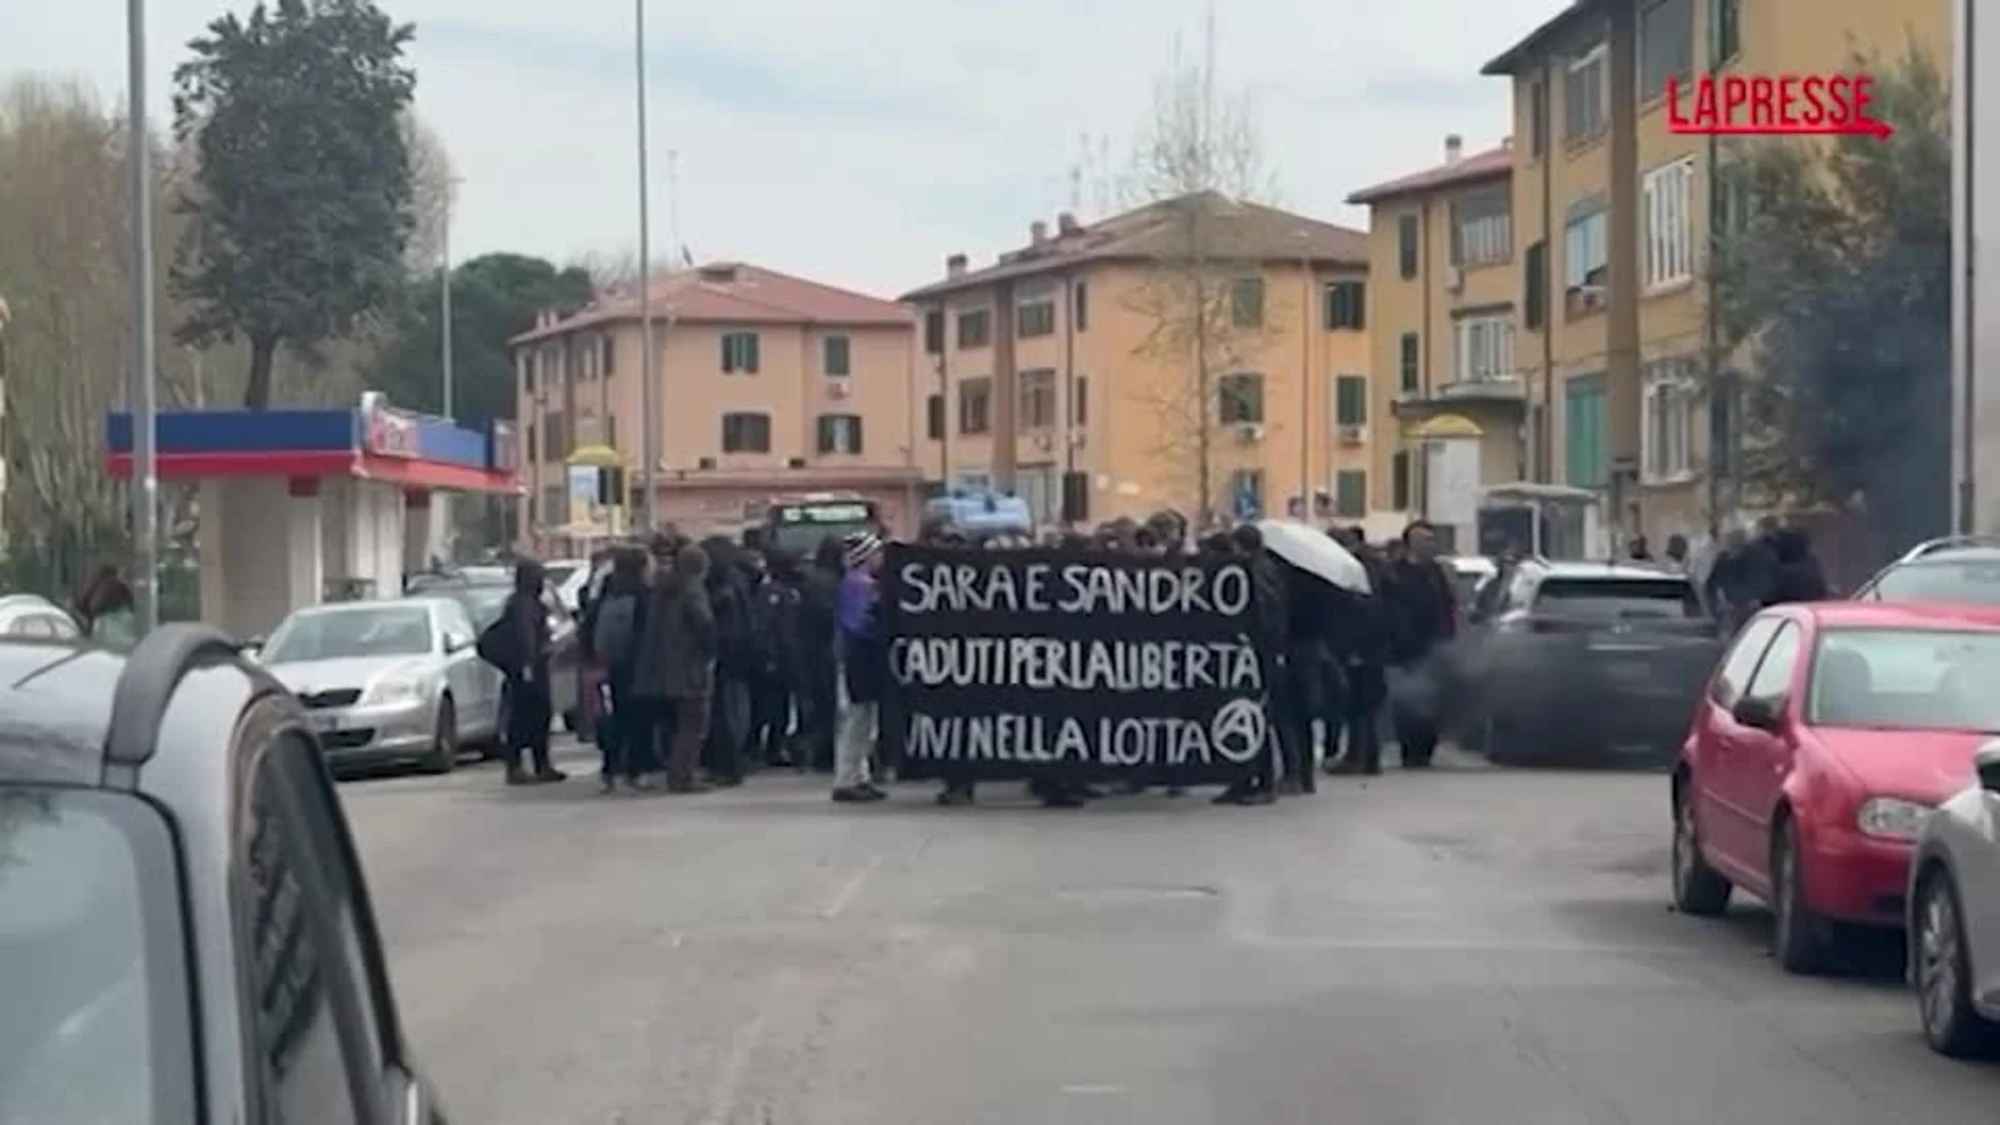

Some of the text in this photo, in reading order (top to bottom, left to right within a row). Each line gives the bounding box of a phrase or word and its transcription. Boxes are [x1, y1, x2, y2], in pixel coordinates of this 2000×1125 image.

[900, 562, 1249, 616] SARA E SANDRO
[889, 636, 1006, 686] CADUTI
[1009, 636, 1071, 689] PER
[1113, 631, 1262, 691] LIBERTÀ
[967, 714, 1089, 761] NELLA
[1100, 717, 1211, 765] LOTTA
